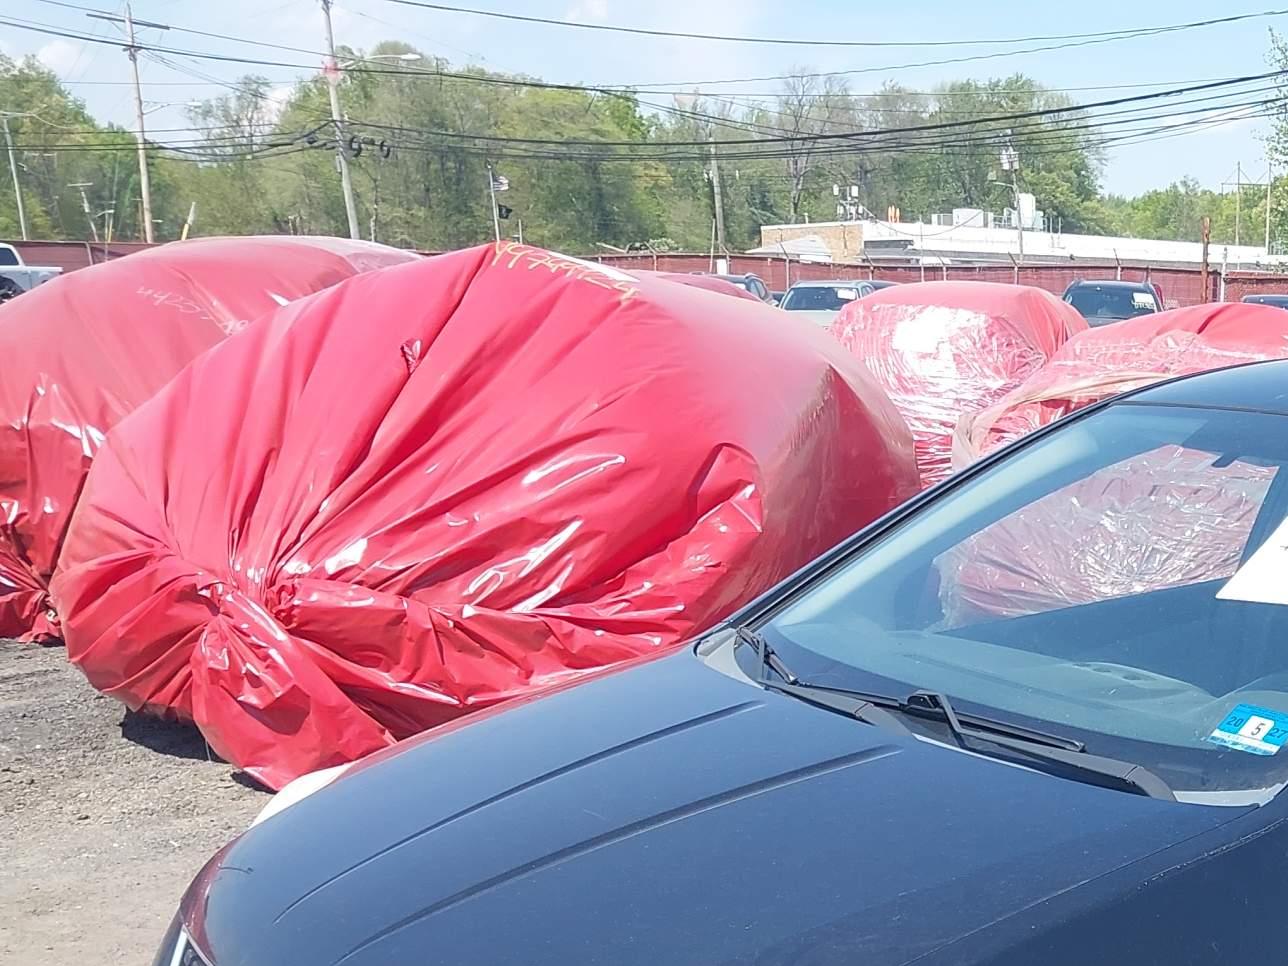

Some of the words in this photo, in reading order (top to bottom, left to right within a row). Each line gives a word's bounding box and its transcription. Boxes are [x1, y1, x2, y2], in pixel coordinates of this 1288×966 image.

[1226, 715, 1245, 728] 20
[1251, 722, 1266, 736] 5
[1269, 727, 1288, 739] 27
